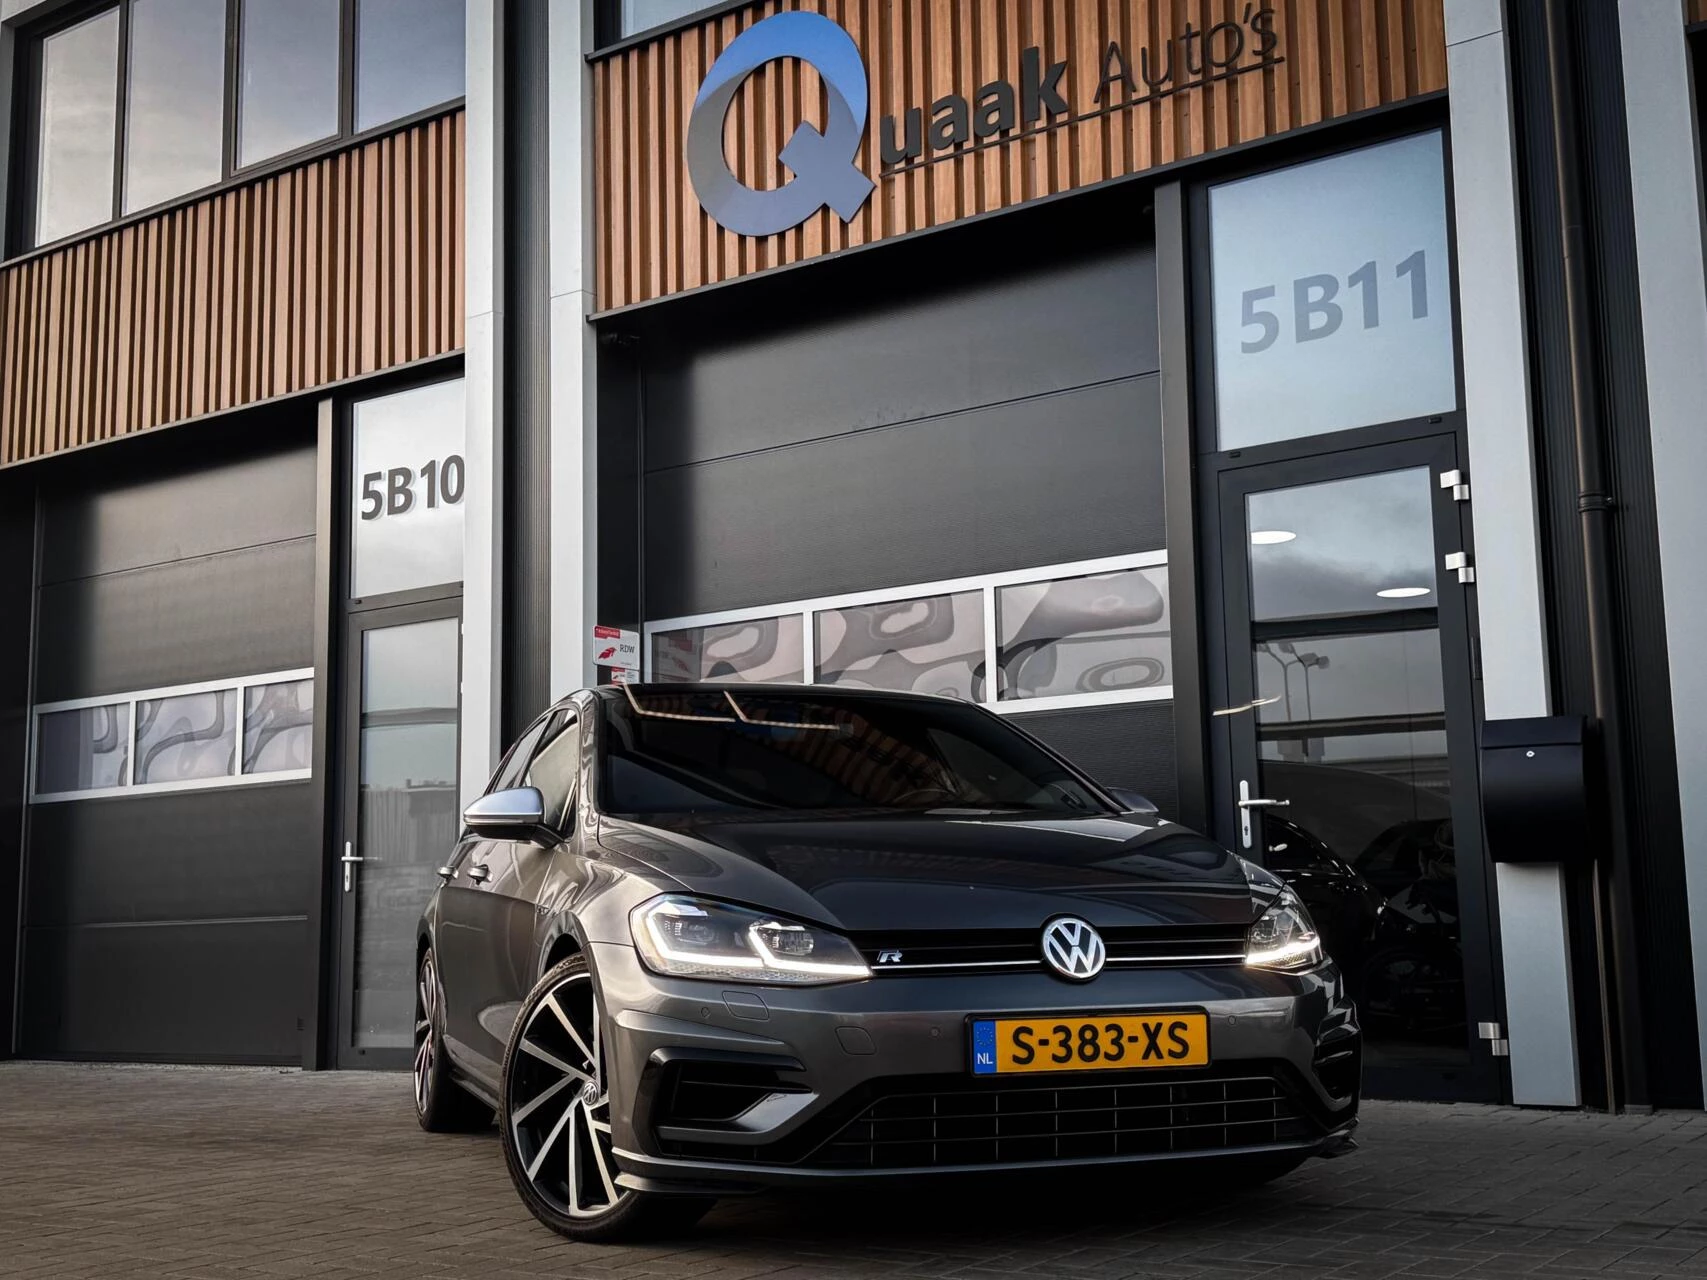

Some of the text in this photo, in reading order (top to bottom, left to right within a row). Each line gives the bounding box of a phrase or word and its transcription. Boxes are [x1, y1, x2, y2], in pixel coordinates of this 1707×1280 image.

[686, 2, 1279, 237] Quaak Auto's
[1240, 249, 1429, 354] 5B11
[361, 454, 466, 521] 5B10
[619, 643, 636, 654] RDW
[976, 1052, 994, 1066] NL
[1011, 1020, 1190, 1066] S-383-XS
